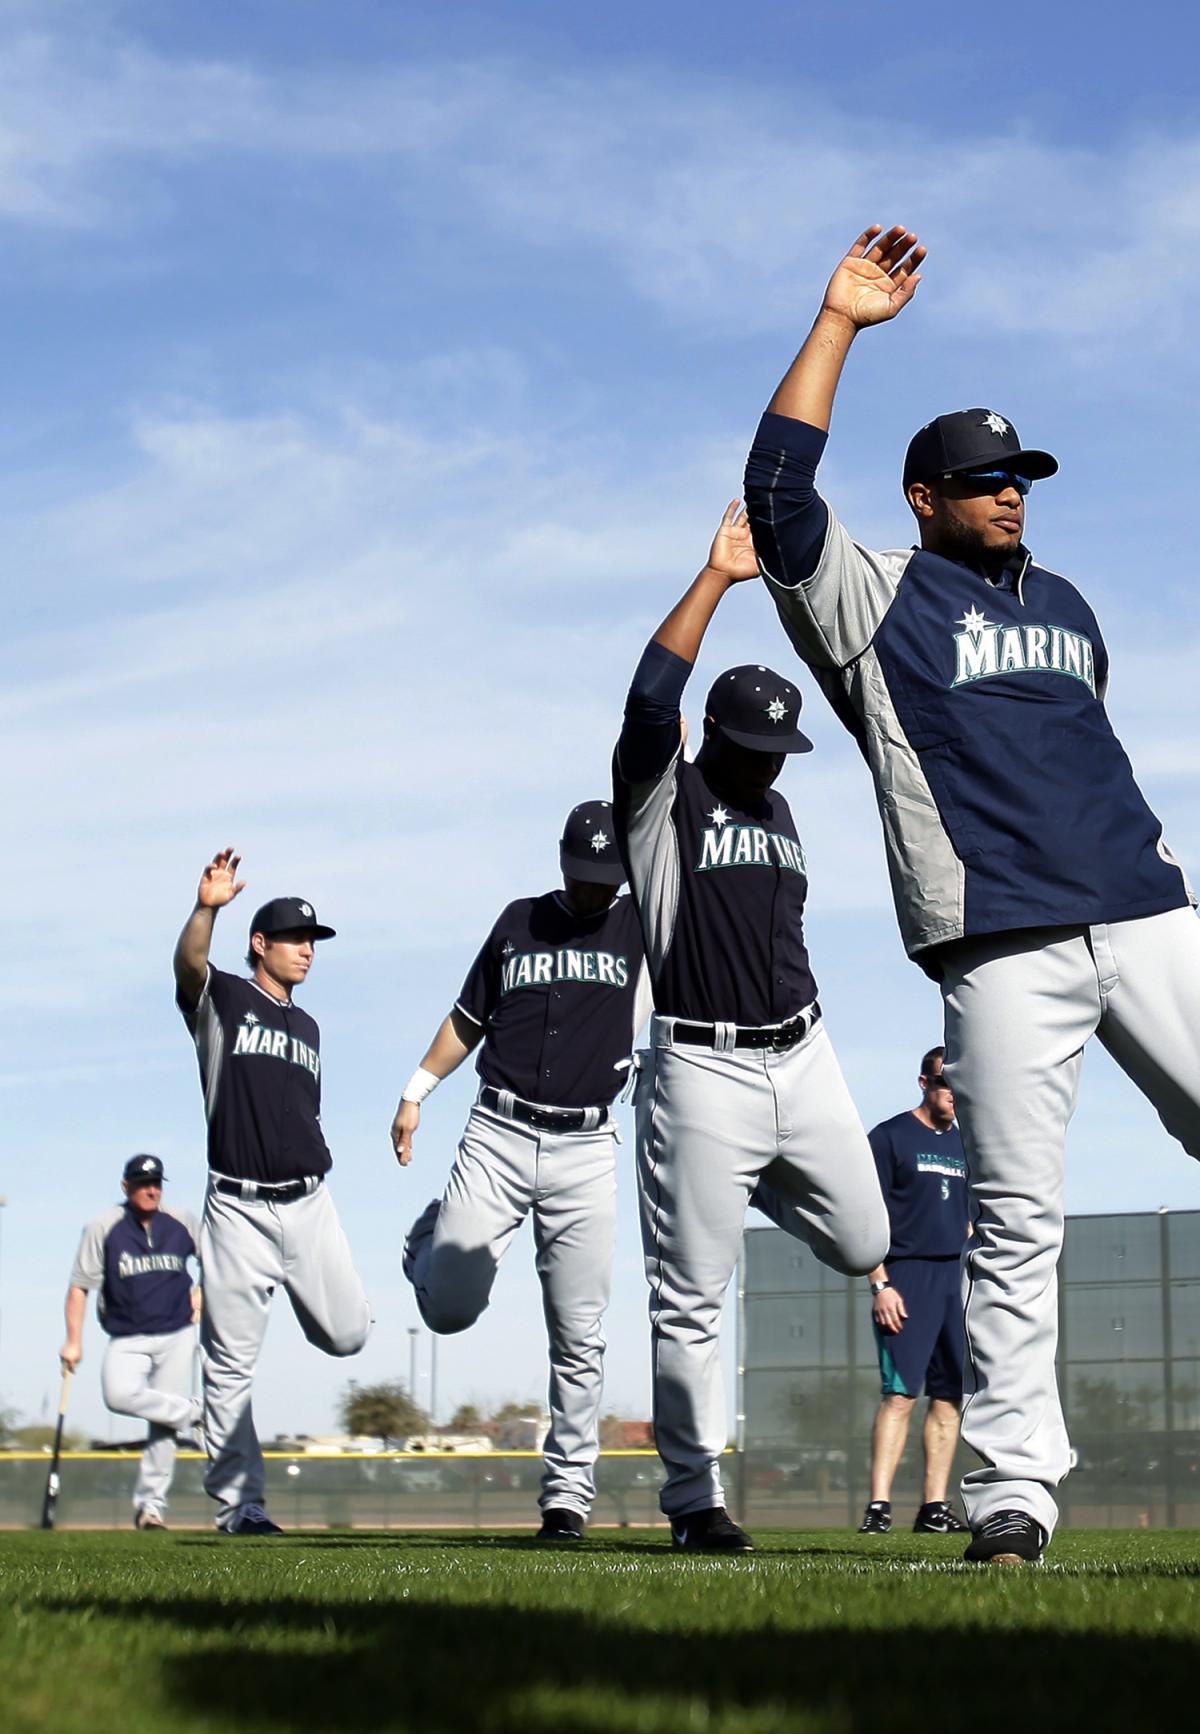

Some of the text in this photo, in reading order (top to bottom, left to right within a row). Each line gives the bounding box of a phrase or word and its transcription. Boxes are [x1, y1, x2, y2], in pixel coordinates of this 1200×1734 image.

[951, 622, 1097, 699] MARINE
[500, 949, 628, 995] MARINERS
[231, 1024, 320, 1079] MARINE
